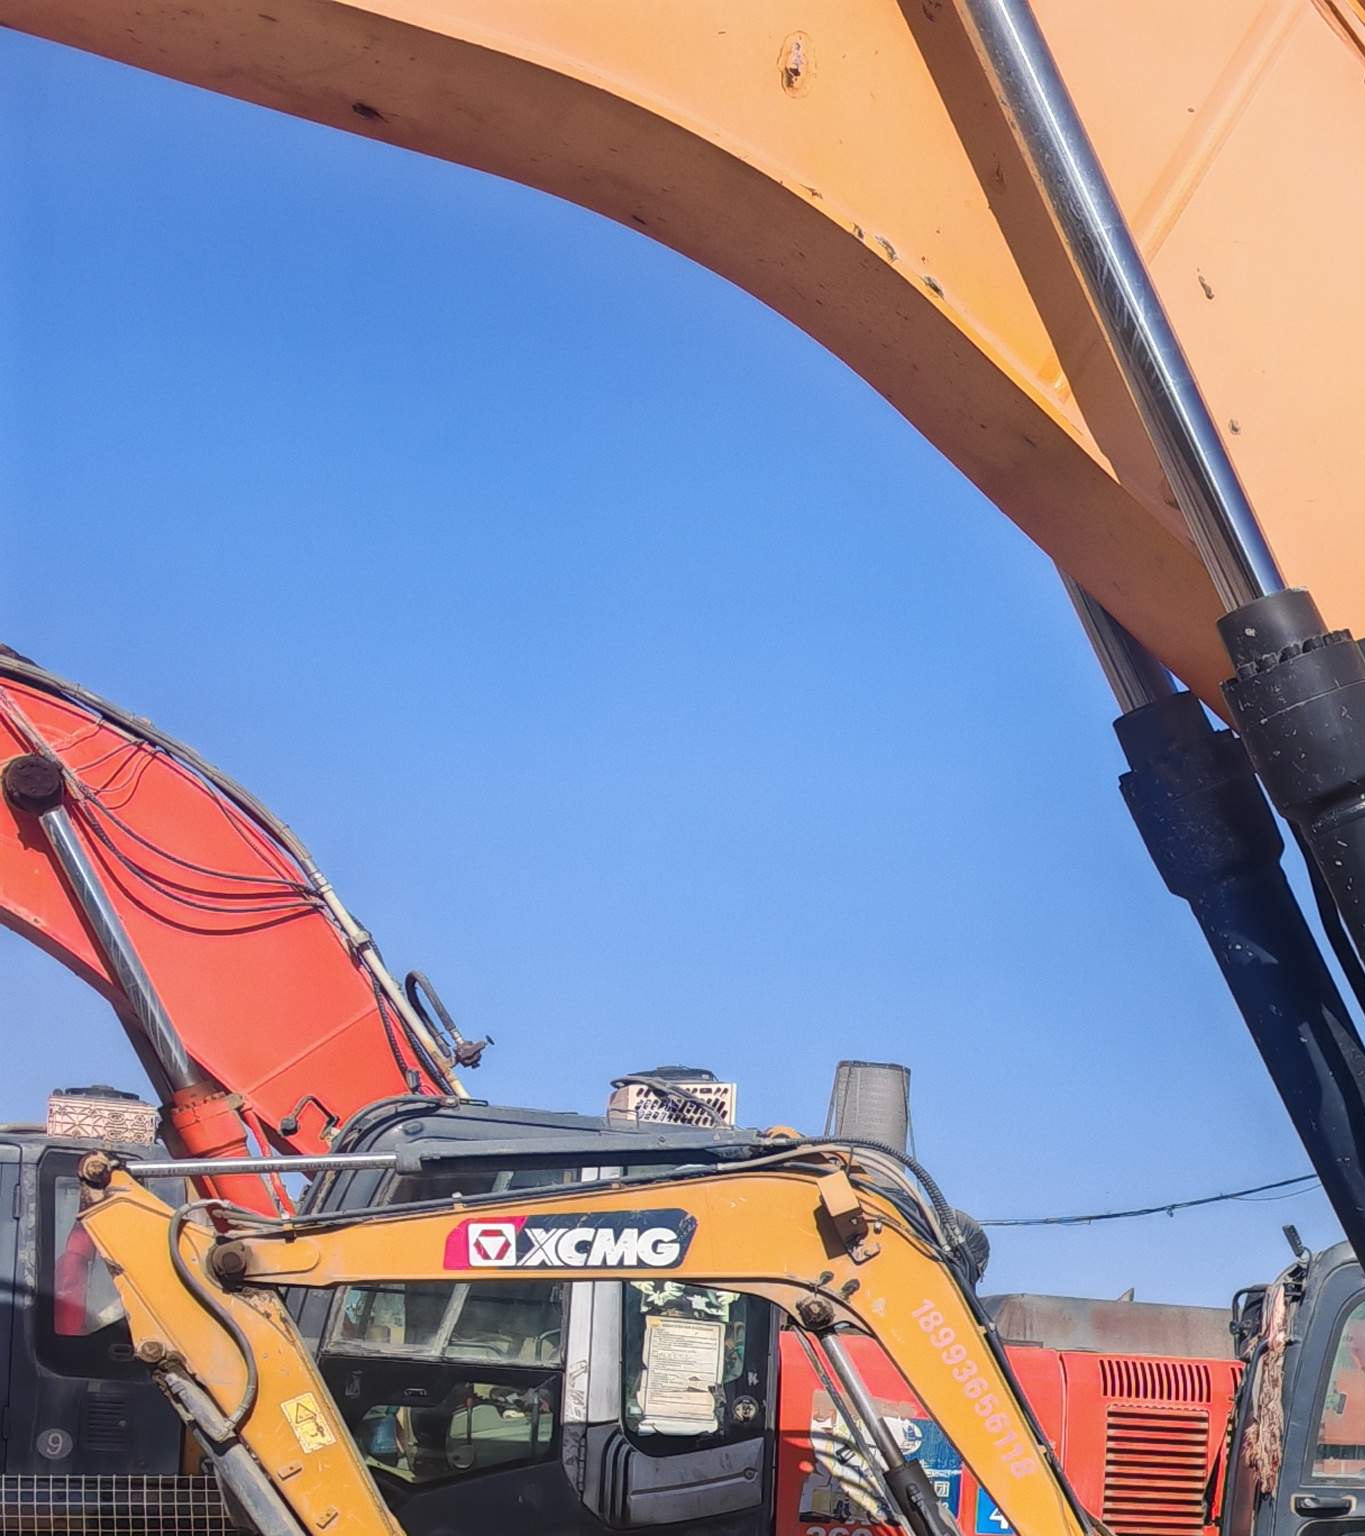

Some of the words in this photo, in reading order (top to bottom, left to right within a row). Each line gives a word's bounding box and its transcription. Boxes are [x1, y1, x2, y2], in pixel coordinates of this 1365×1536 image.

[516, 1227, 680, 1267] XCMG
[911, 1299, 1037, 1479] 18993656118
[46, 1432, 63, 1455] 9
